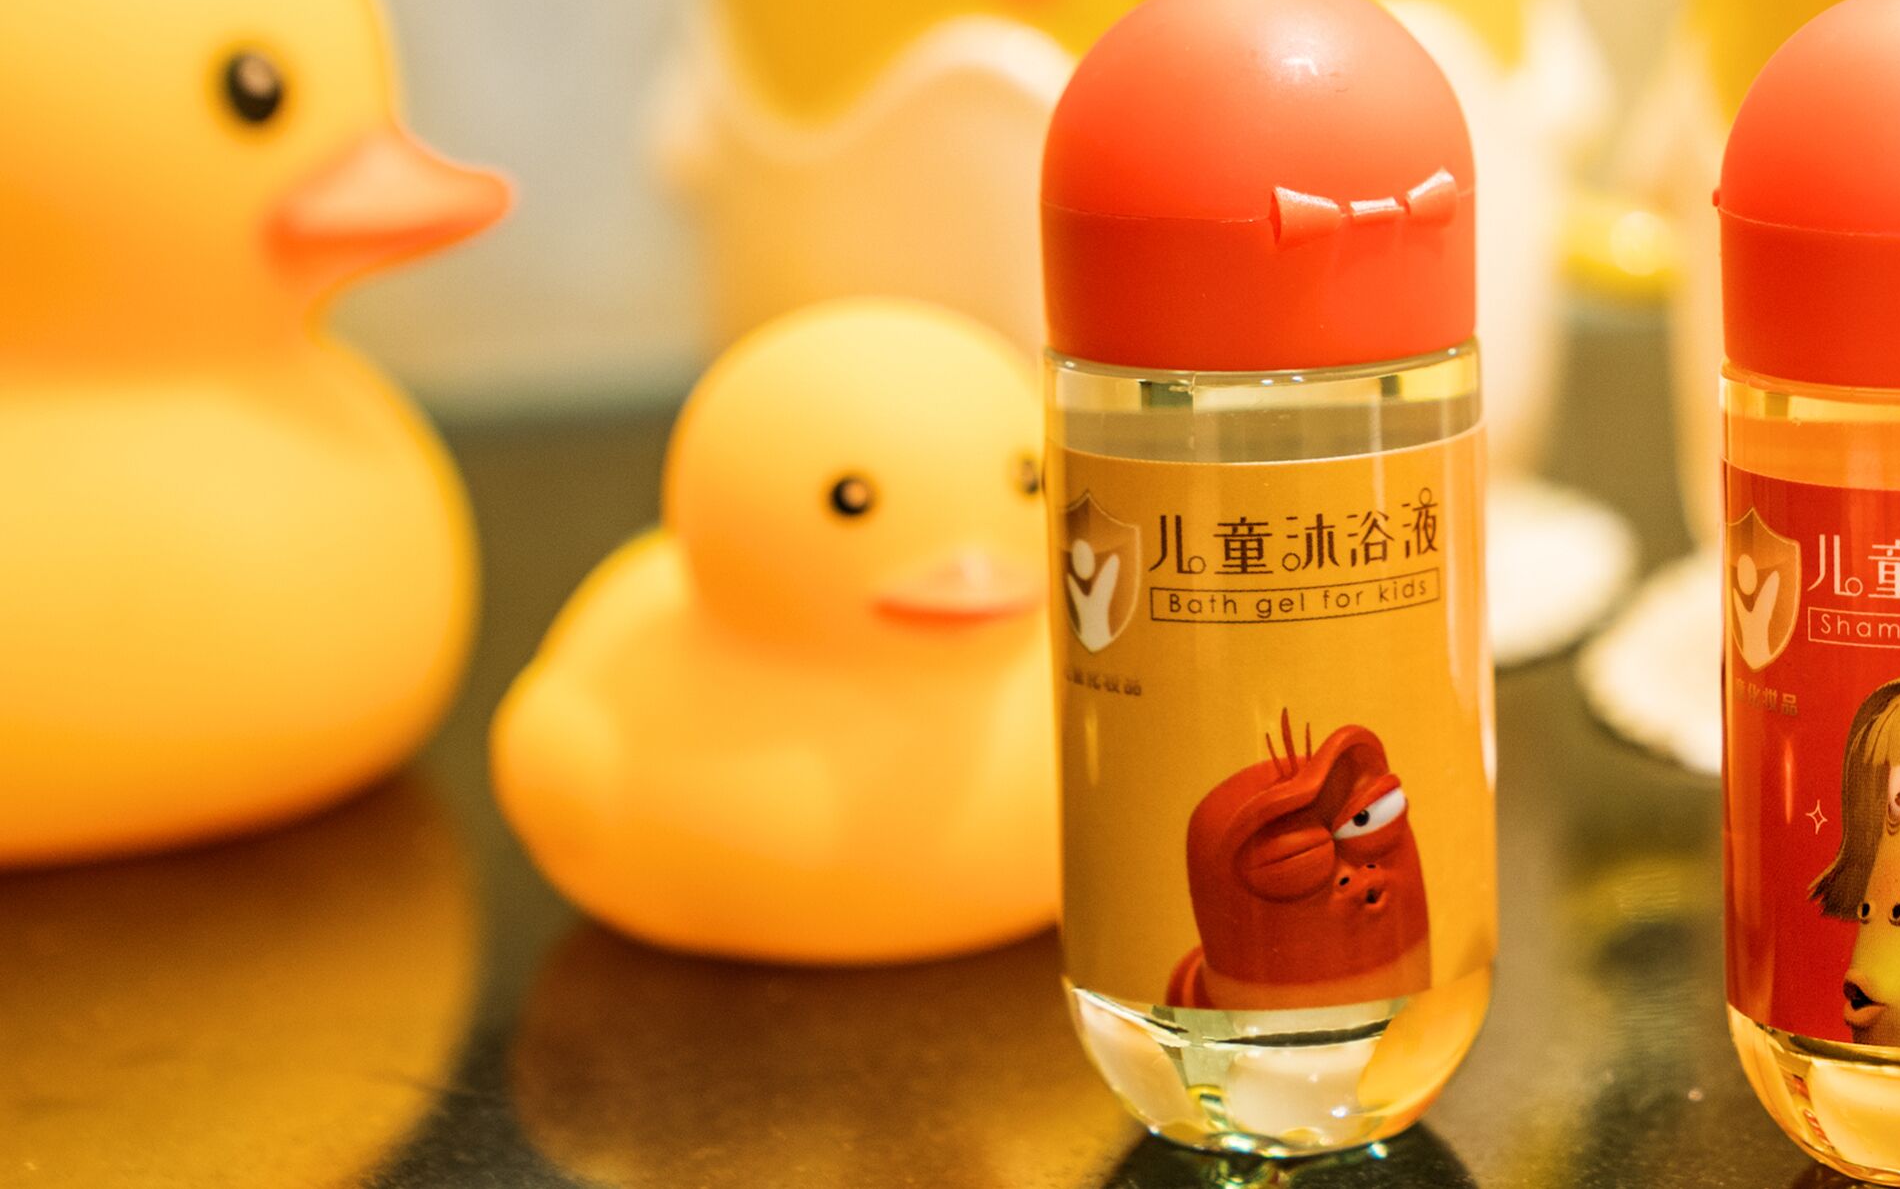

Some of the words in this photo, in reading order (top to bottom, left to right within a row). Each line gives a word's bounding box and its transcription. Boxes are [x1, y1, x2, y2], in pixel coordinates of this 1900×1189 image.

[1149, 487, 1439, 575] 儿童沐浴液
[1169, 593, 1238, 615] Bath
[1255, 594, 1305, 619] gel
[1323, 590, 1364, 610] for
[1379, 580, 1428, 602] kids
